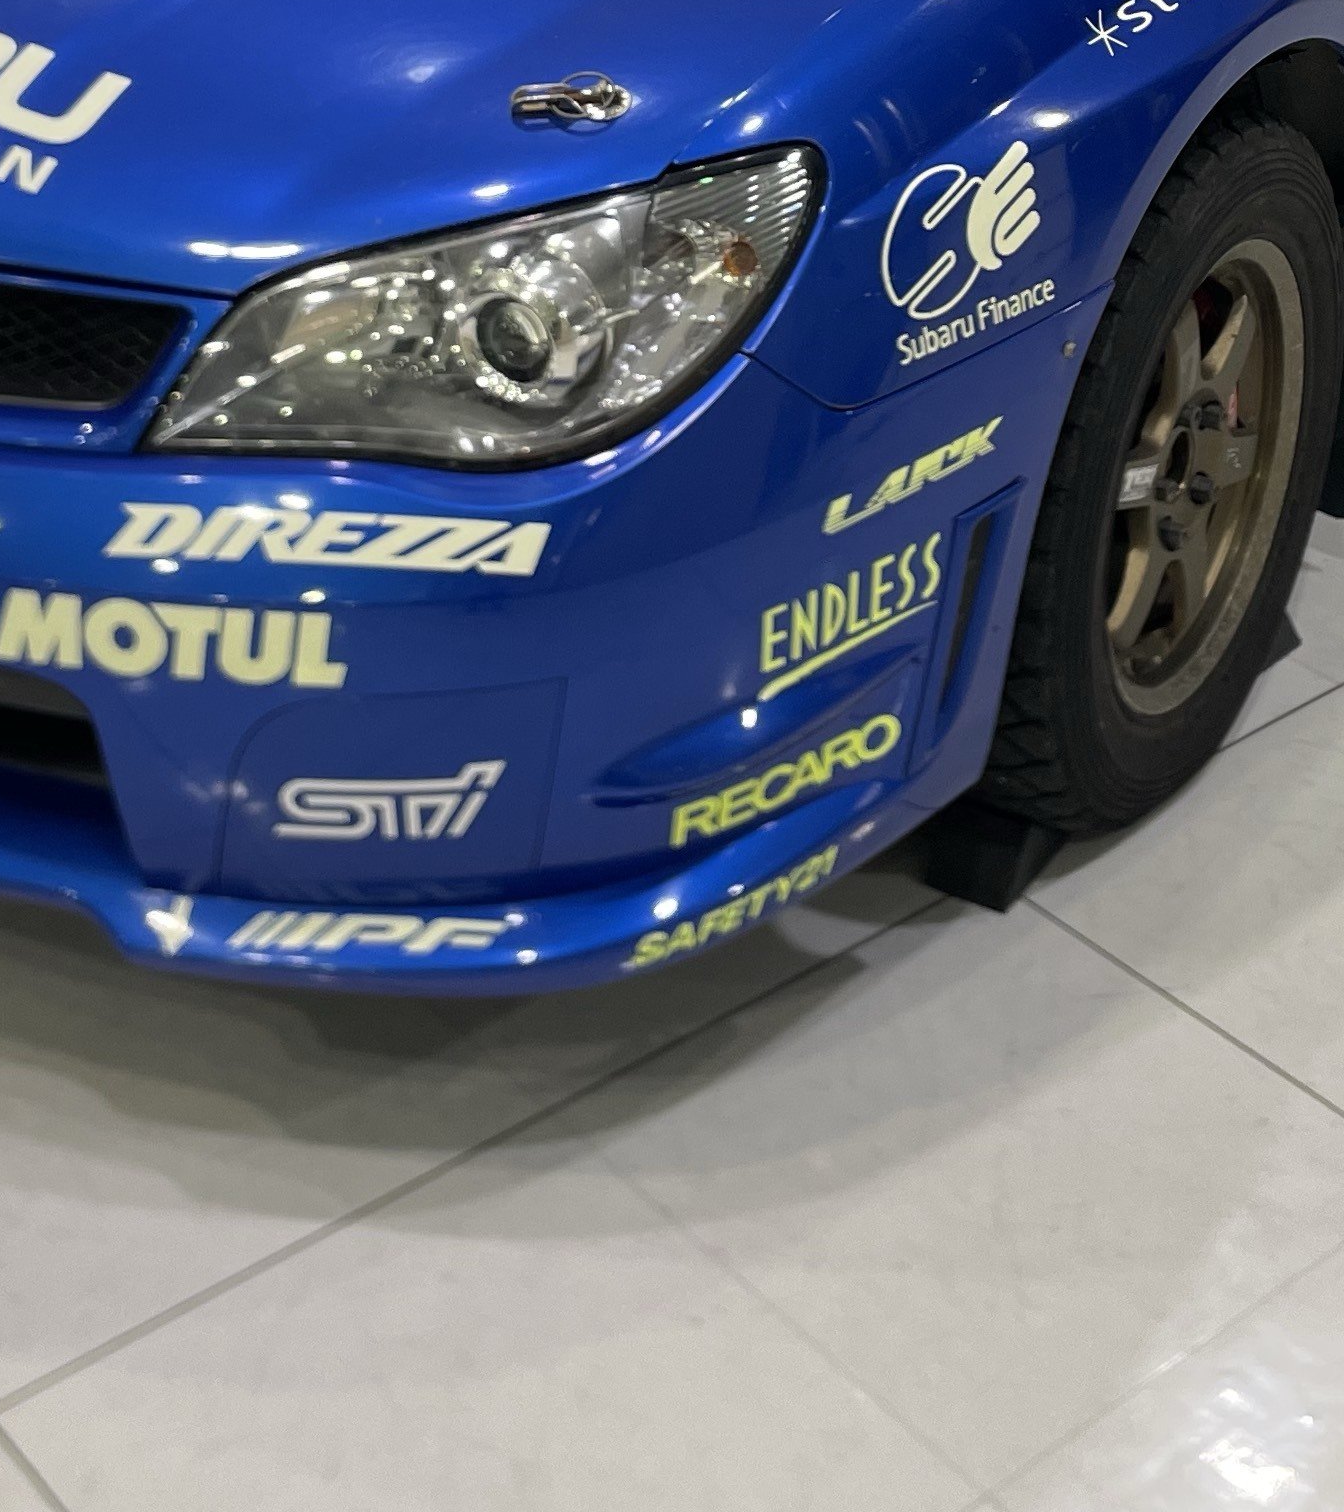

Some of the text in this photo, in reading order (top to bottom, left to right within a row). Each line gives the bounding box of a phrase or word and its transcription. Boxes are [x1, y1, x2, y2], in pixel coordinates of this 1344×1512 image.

[895, 278, 1056, 366] Subaru Finance
[102, 501, 552, 577] DIREZZA
[760, 532, 942, 673] ENDLESS
[669, 713, 902, 849] RECARO
